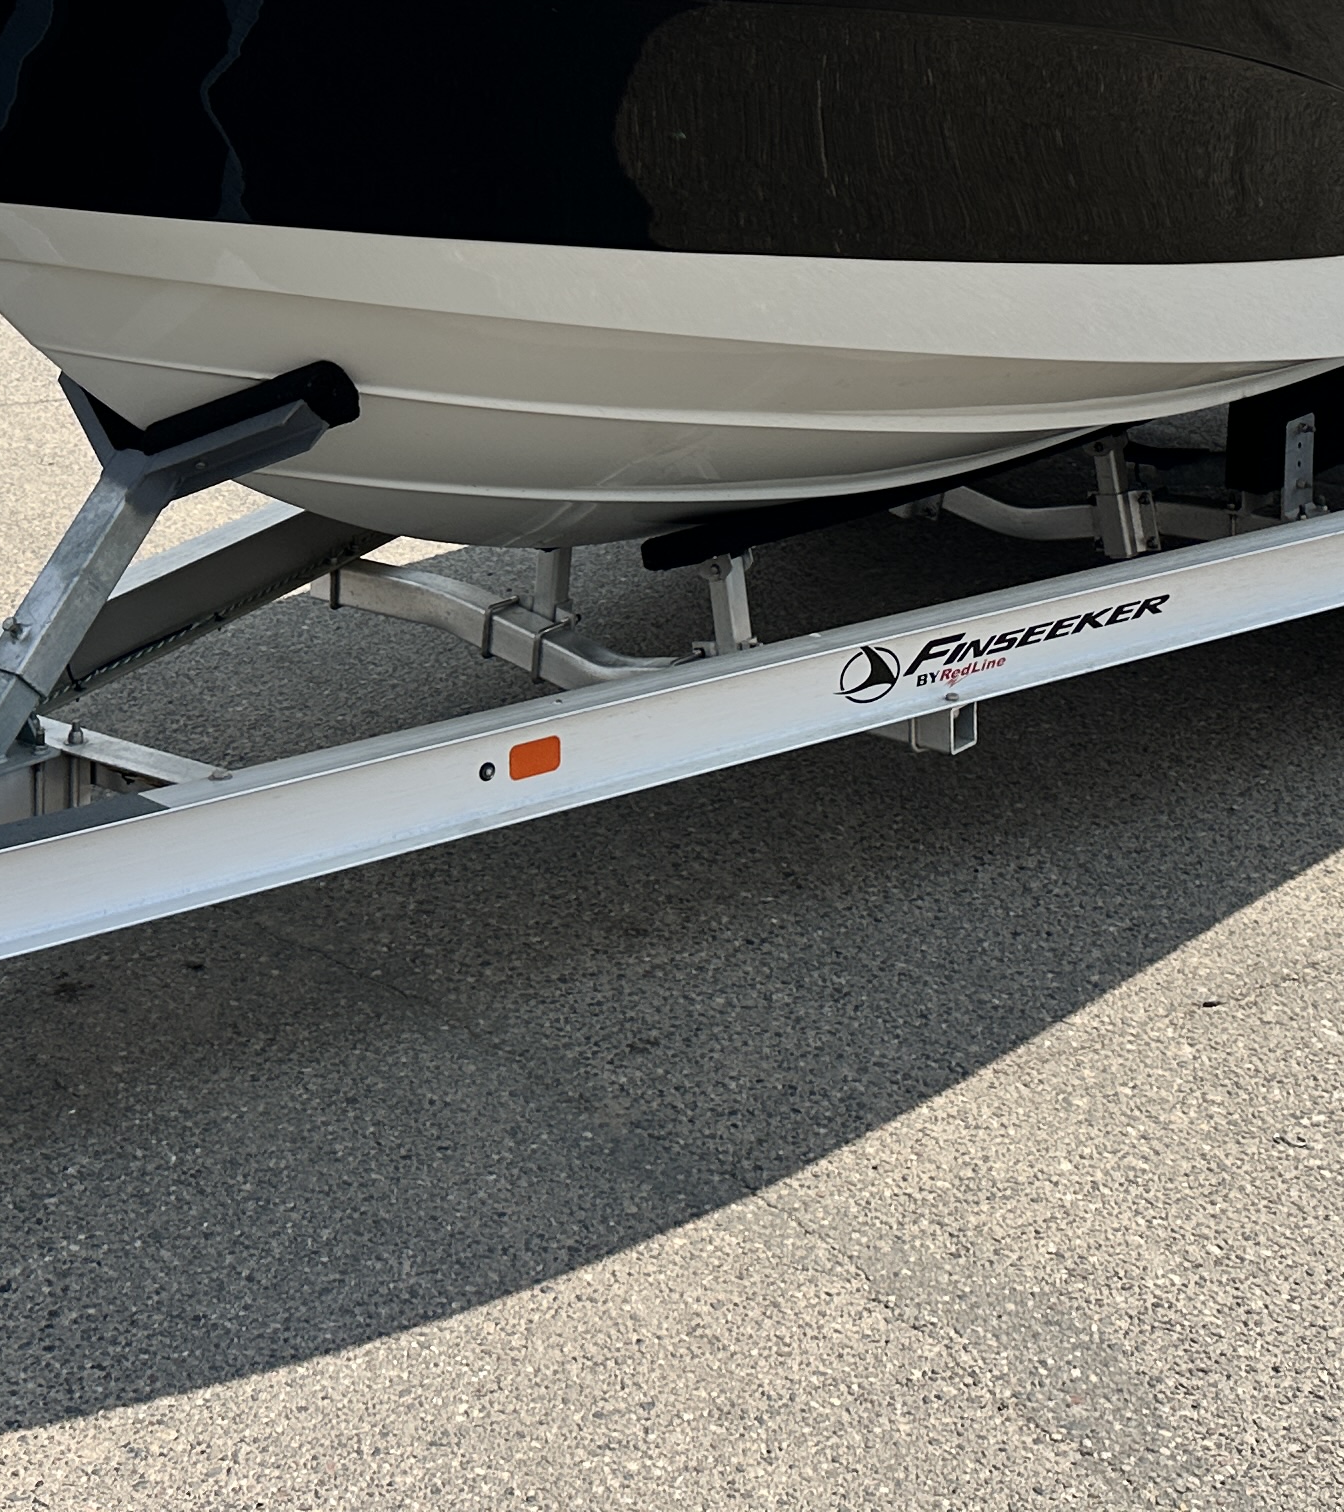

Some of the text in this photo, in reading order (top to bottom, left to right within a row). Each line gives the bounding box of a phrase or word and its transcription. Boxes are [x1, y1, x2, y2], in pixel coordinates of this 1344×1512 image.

[902, 593, 1171, 677] FINSEEKER
[916, 656, 1006, 687] BY RedLine
